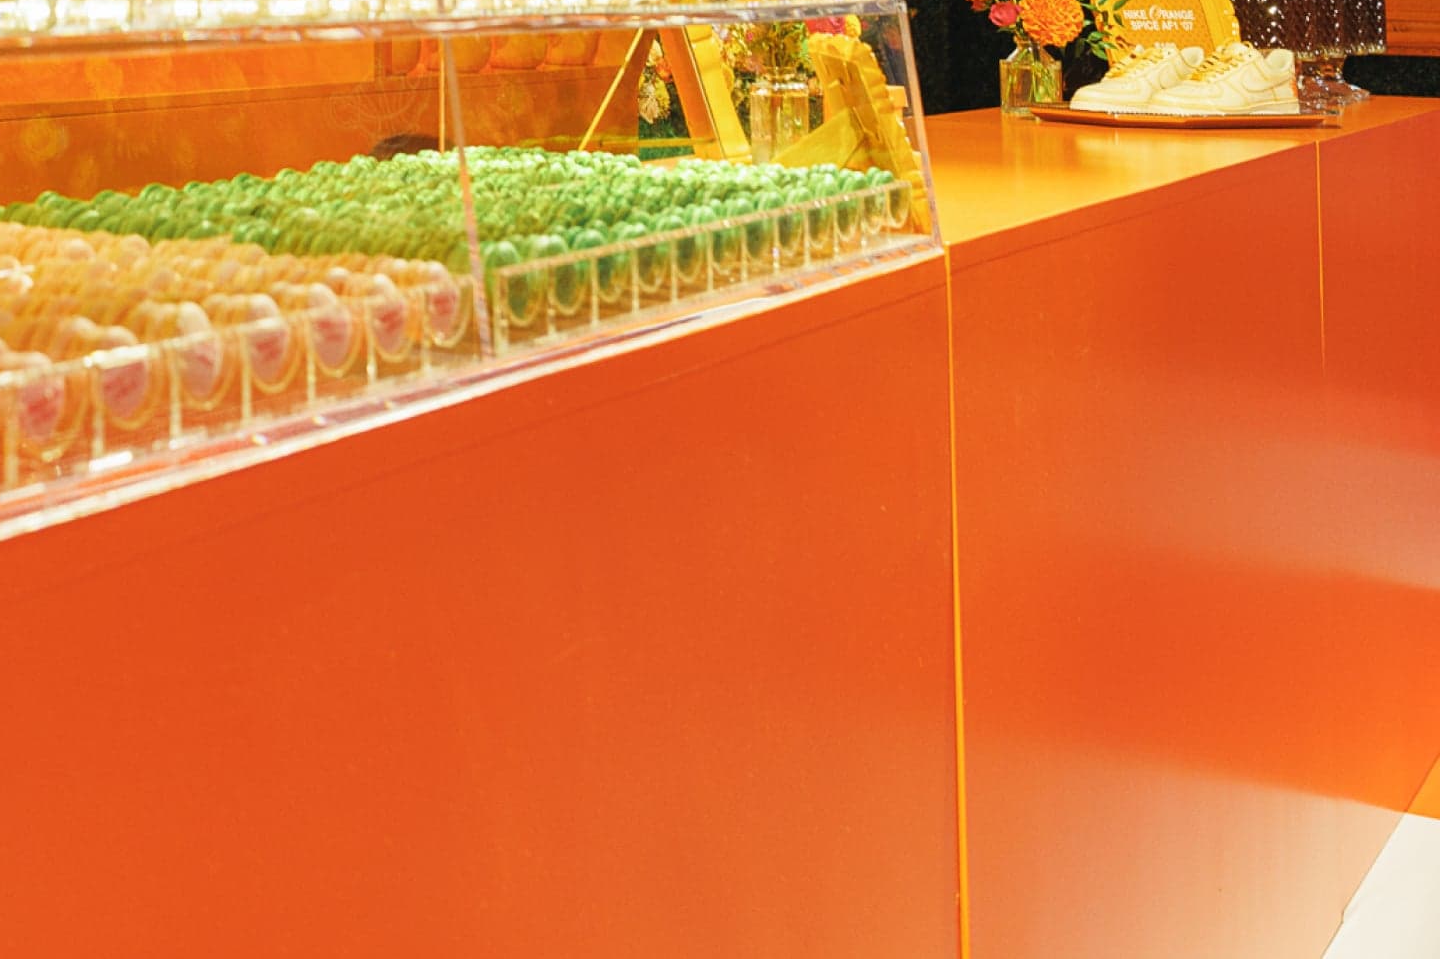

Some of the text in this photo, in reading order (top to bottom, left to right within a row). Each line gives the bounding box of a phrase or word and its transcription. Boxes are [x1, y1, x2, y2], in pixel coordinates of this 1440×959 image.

[1123, 4, 1195, 20] NIKE ORANGE
[1130, 20, 1160, 31] SPICE
[1161, 20, 1179, 31] AF1
